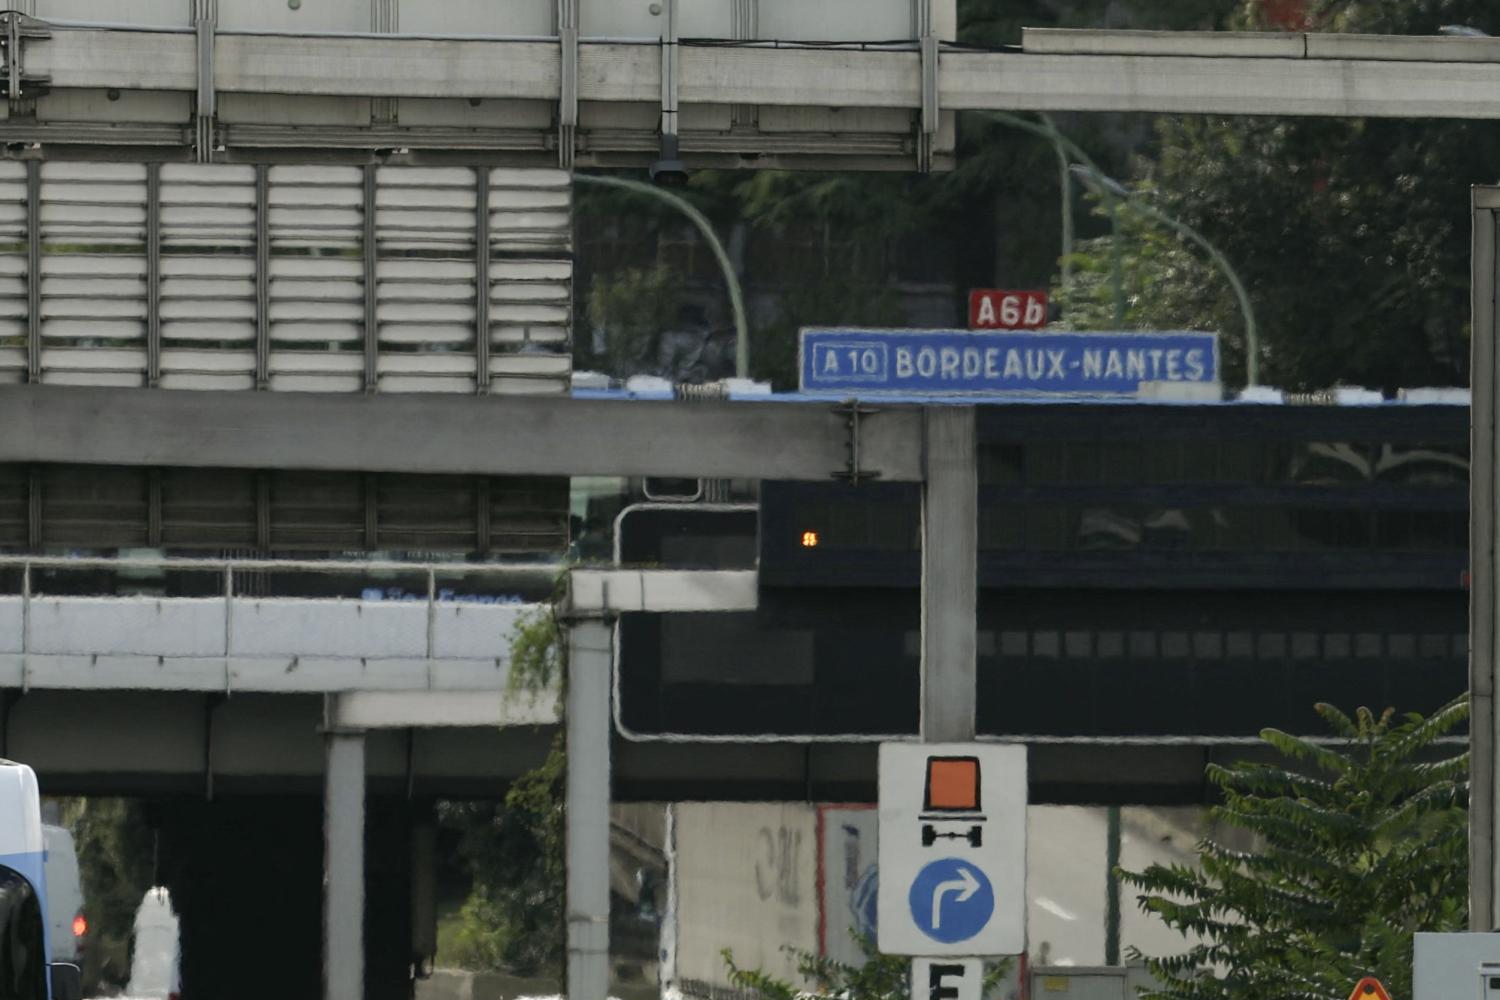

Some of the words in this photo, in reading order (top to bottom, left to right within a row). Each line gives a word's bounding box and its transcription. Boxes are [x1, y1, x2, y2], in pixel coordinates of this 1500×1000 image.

[976, 295, 1045, 326] A6b
[823, 350, 839, 372] A
[849, 349, 876, 373] 10
[896, 347, 1204, 380] BORDEAUX-NANTES
